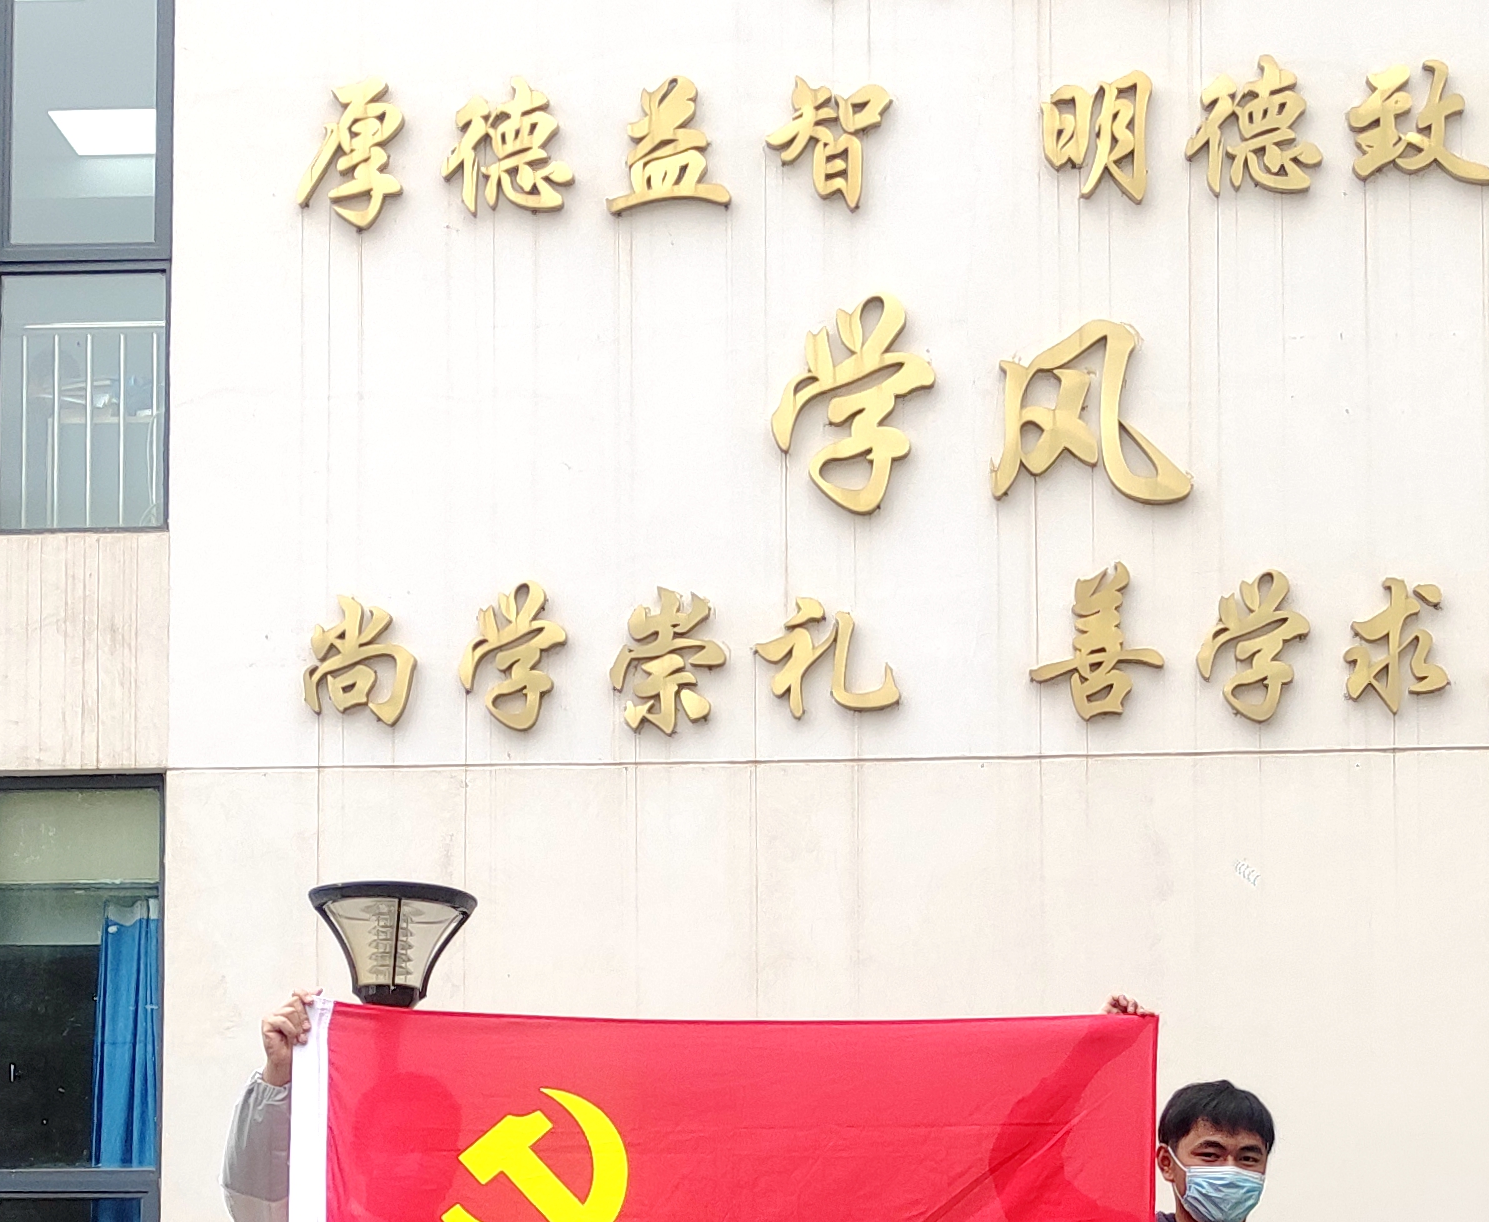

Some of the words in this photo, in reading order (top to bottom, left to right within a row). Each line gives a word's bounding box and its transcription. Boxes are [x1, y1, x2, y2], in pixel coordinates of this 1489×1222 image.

[298, 72, 893, 231] 厚德益智
[771, 294, 1195, 516] 学风
[301, 580, 902, 732] 尚学崇礼
